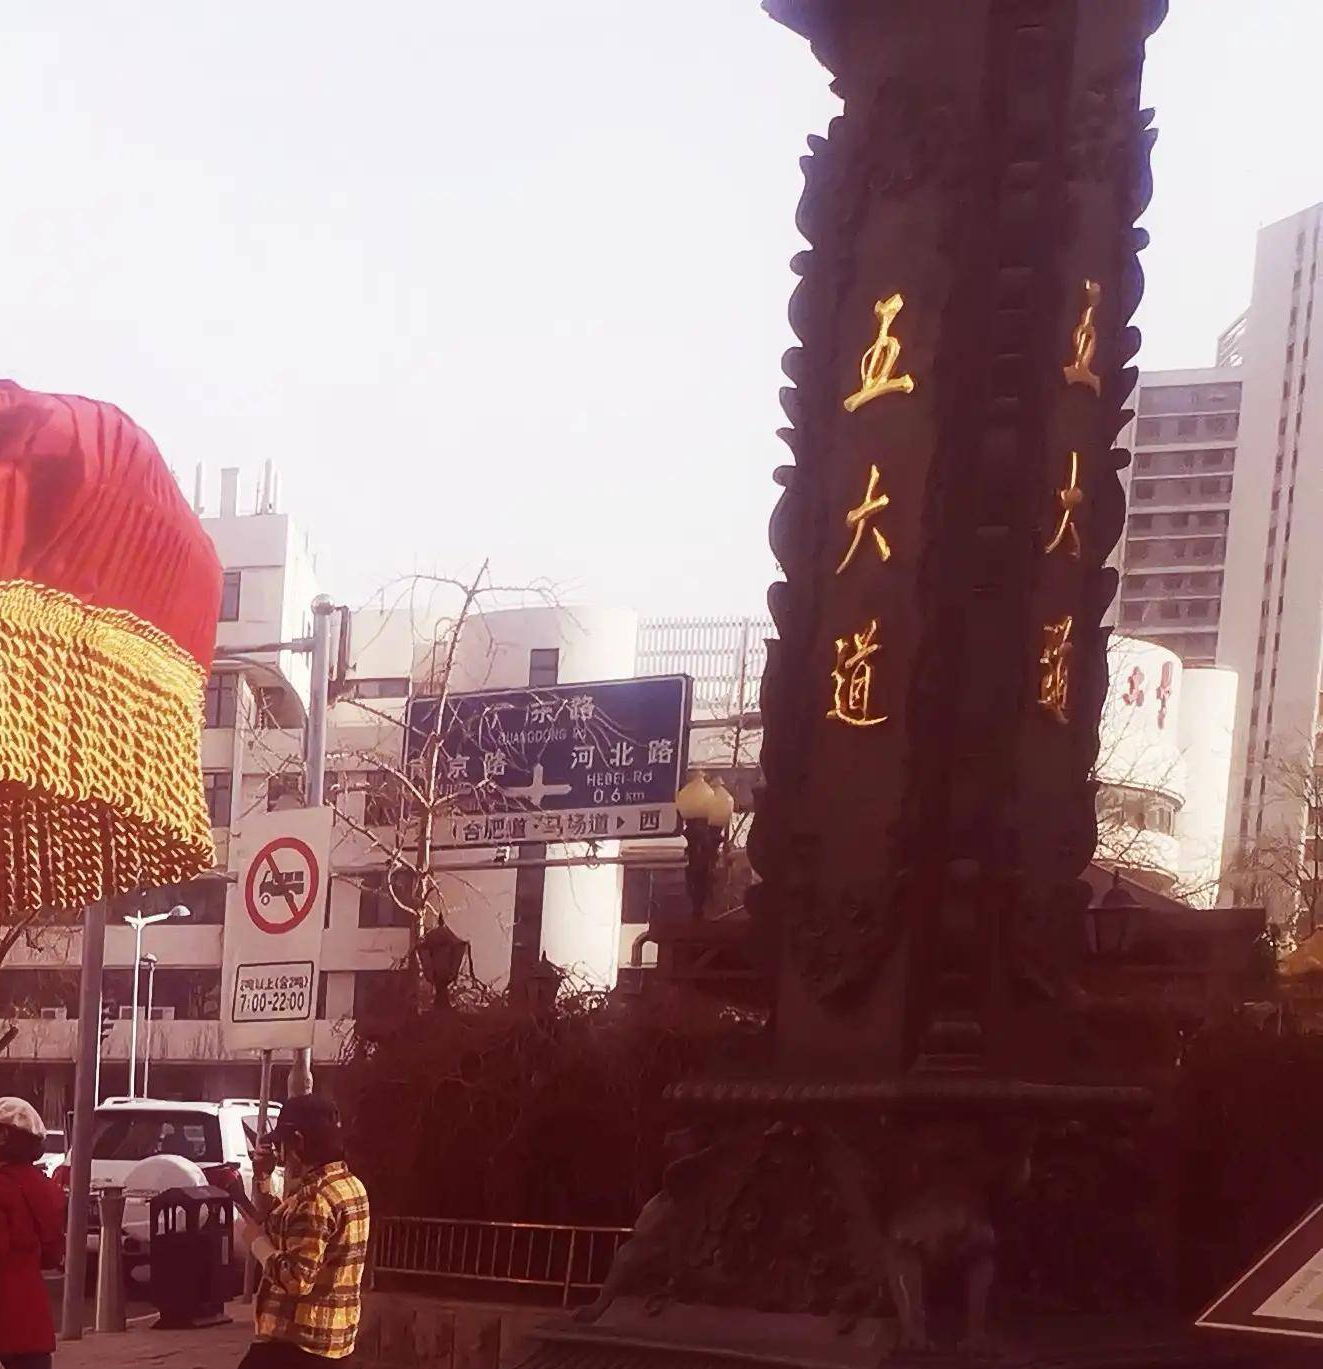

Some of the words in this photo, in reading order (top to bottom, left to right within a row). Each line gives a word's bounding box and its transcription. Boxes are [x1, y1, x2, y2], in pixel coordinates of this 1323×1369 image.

[825, 293, 915, 726] 五大道
[570, 738, 674, 770] 河北路
[639, 809, 661, 832] 西
[239, 991, 305, 1013] 7:00-22:00
